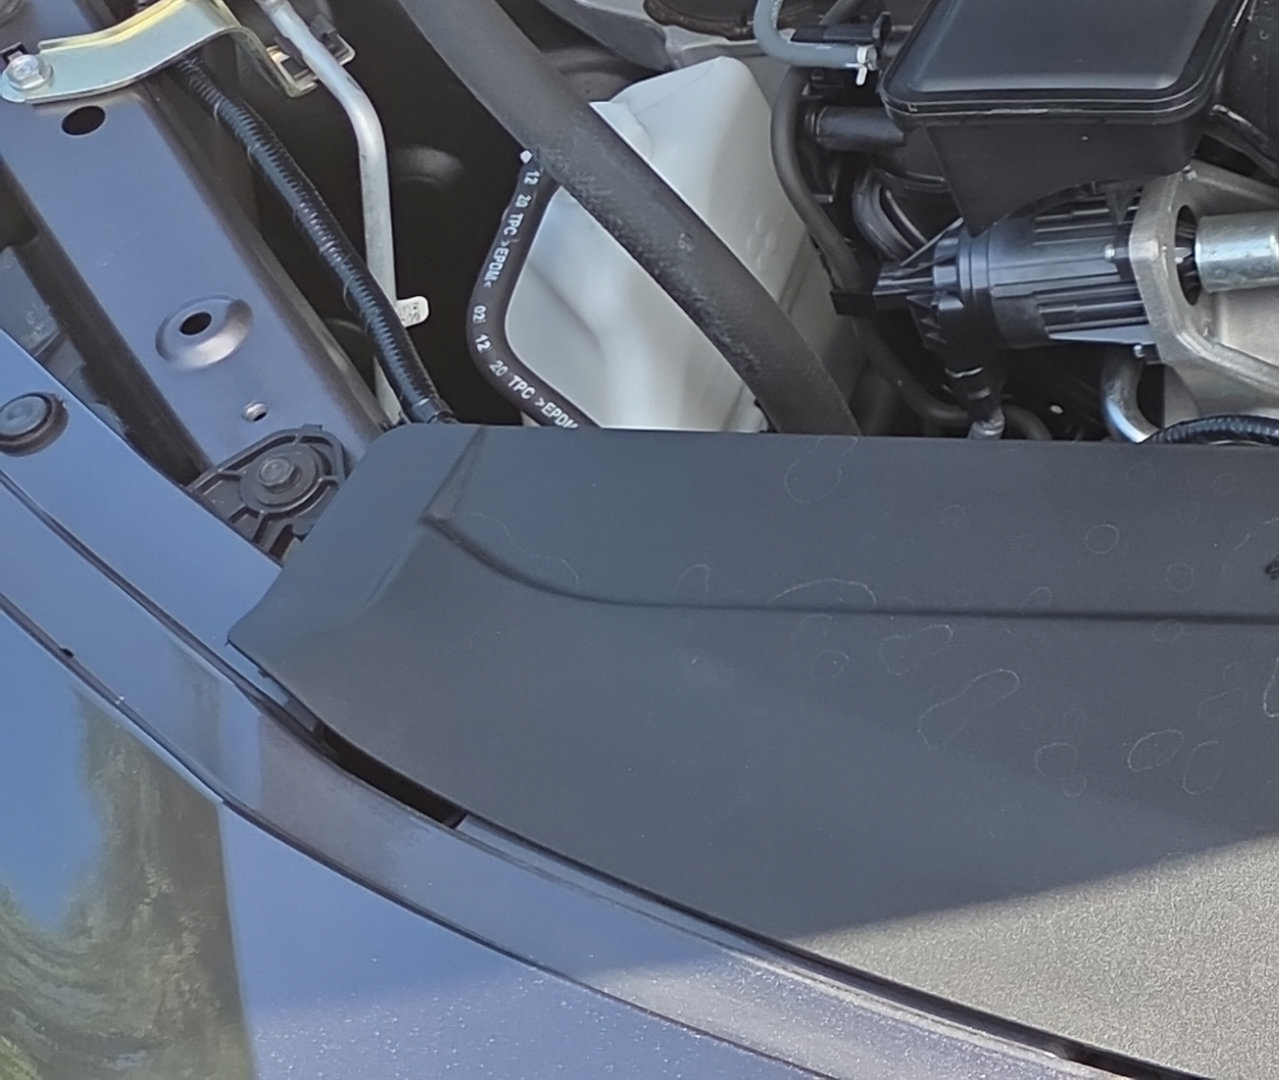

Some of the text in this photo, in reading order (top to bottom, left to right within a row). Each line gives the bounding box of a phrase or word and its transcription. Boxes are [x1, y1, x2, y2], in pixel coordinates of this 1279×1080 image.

[524, 170, 540, 185] 12
[516, 194, 532, 208] 20
[504, 213, 524, 236] TPC
[474, 334, 492, 353] 12
[489, 360, 509, 376] 20
[508, 375, 537, 400] TPC
